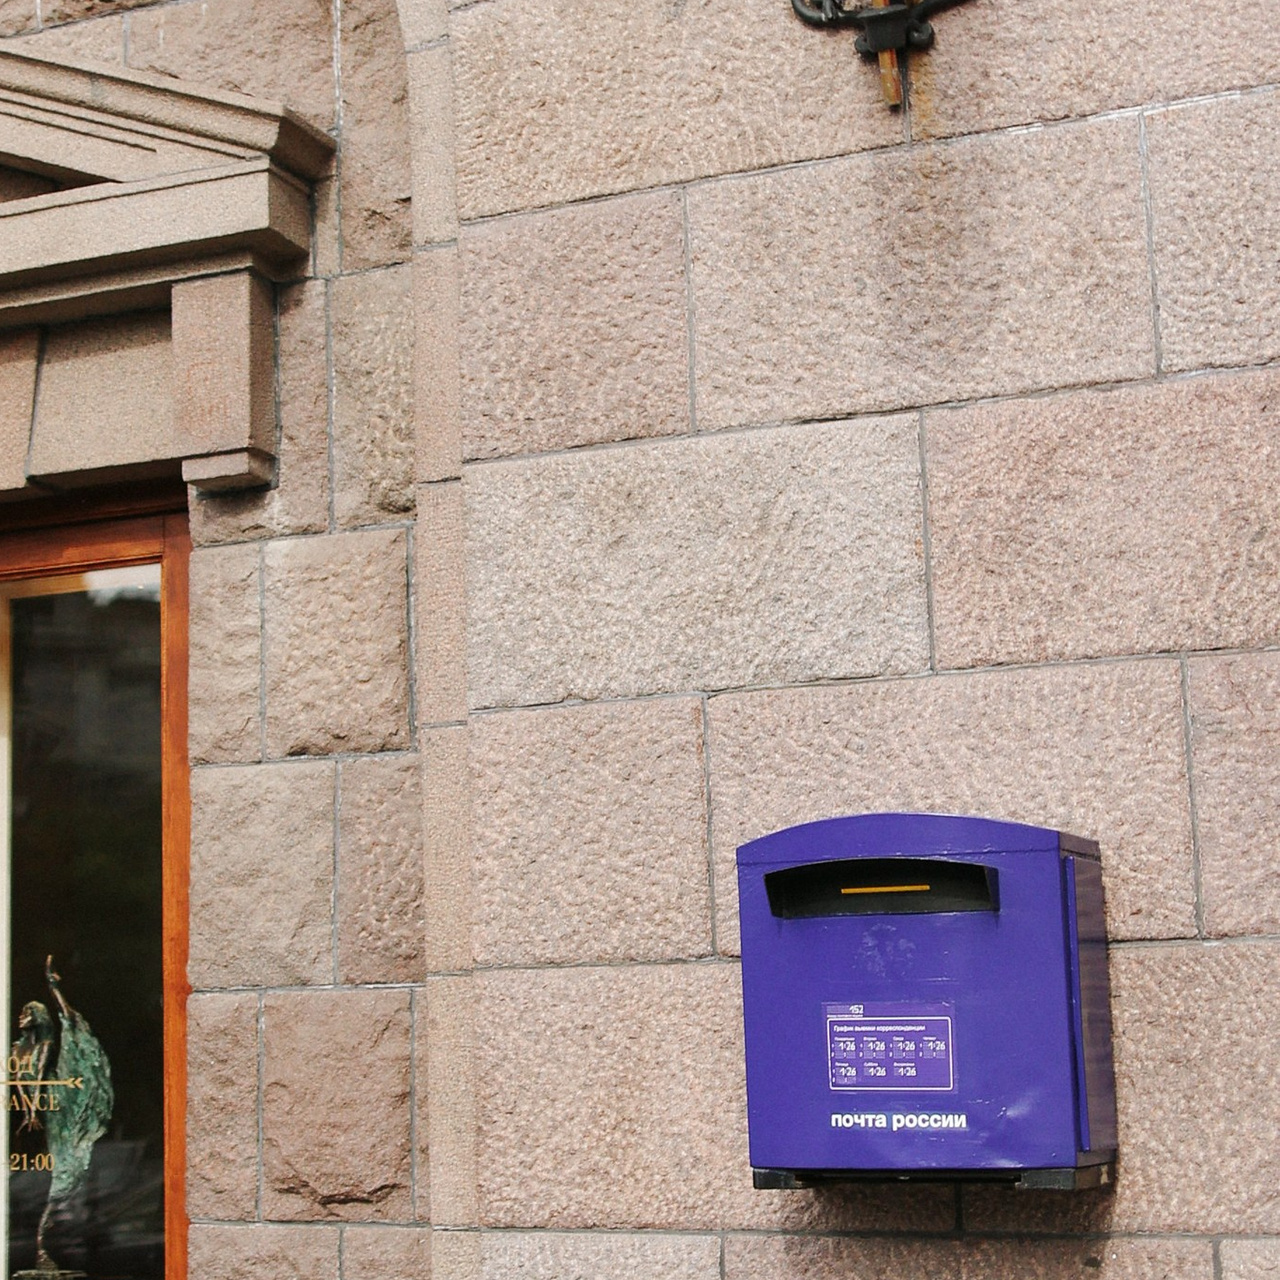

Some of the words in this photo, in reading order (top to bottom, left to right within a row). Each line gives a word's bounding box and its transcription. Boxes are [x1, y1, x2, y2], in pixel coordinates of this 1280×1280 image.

[831, 1113, 887, 1128] почта
[892, 1113, 967, 1131] россии
[10, 1153, 55, 1171] 21:00
